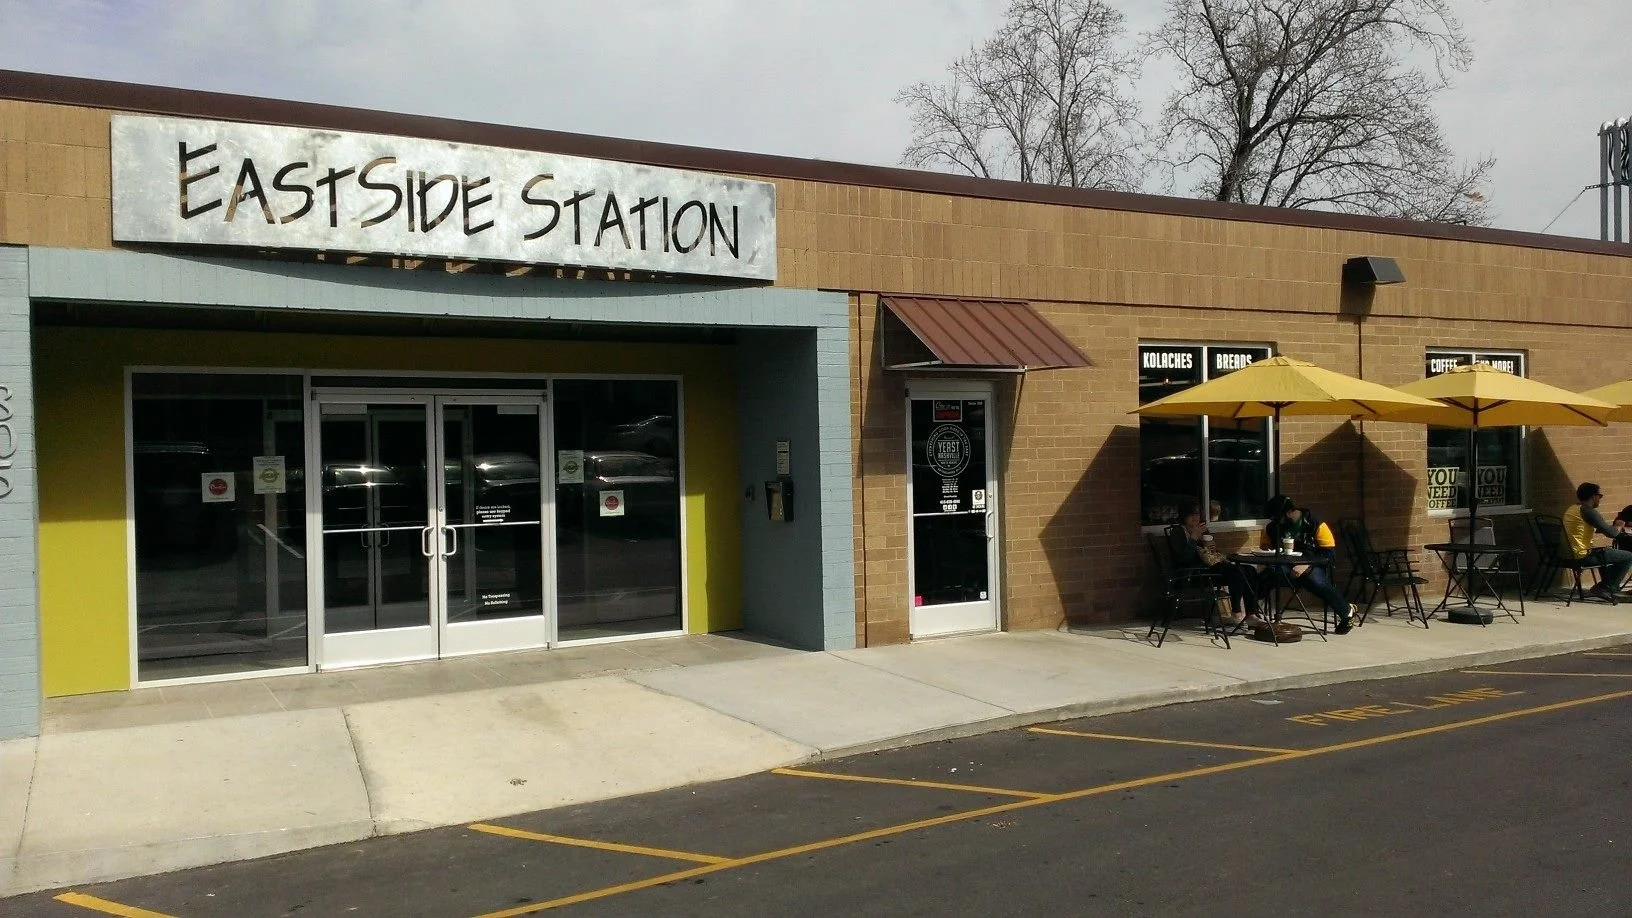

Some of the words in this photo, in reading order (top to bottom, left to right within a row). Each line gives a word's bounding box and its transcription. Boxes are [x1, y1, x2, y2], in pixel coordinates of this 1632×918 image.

[179, 141, 495, 237] EASTSIDE
[521, 173, 739, 260] STATION
[1143, 352, 1193, 369] KOLACHES
[1216, 353, 1253, 370] BREADS
[1431, 358, 1458, 373] COFFEE
[938, 441, 960, 453] YEAST
[1427, 468, 1458, 486] YOU
[1428, 499, 1457, 509] OFFEE
[1285, 704, 1414, 726] FIRE
[1389, 687, 1526, 710] LANE
